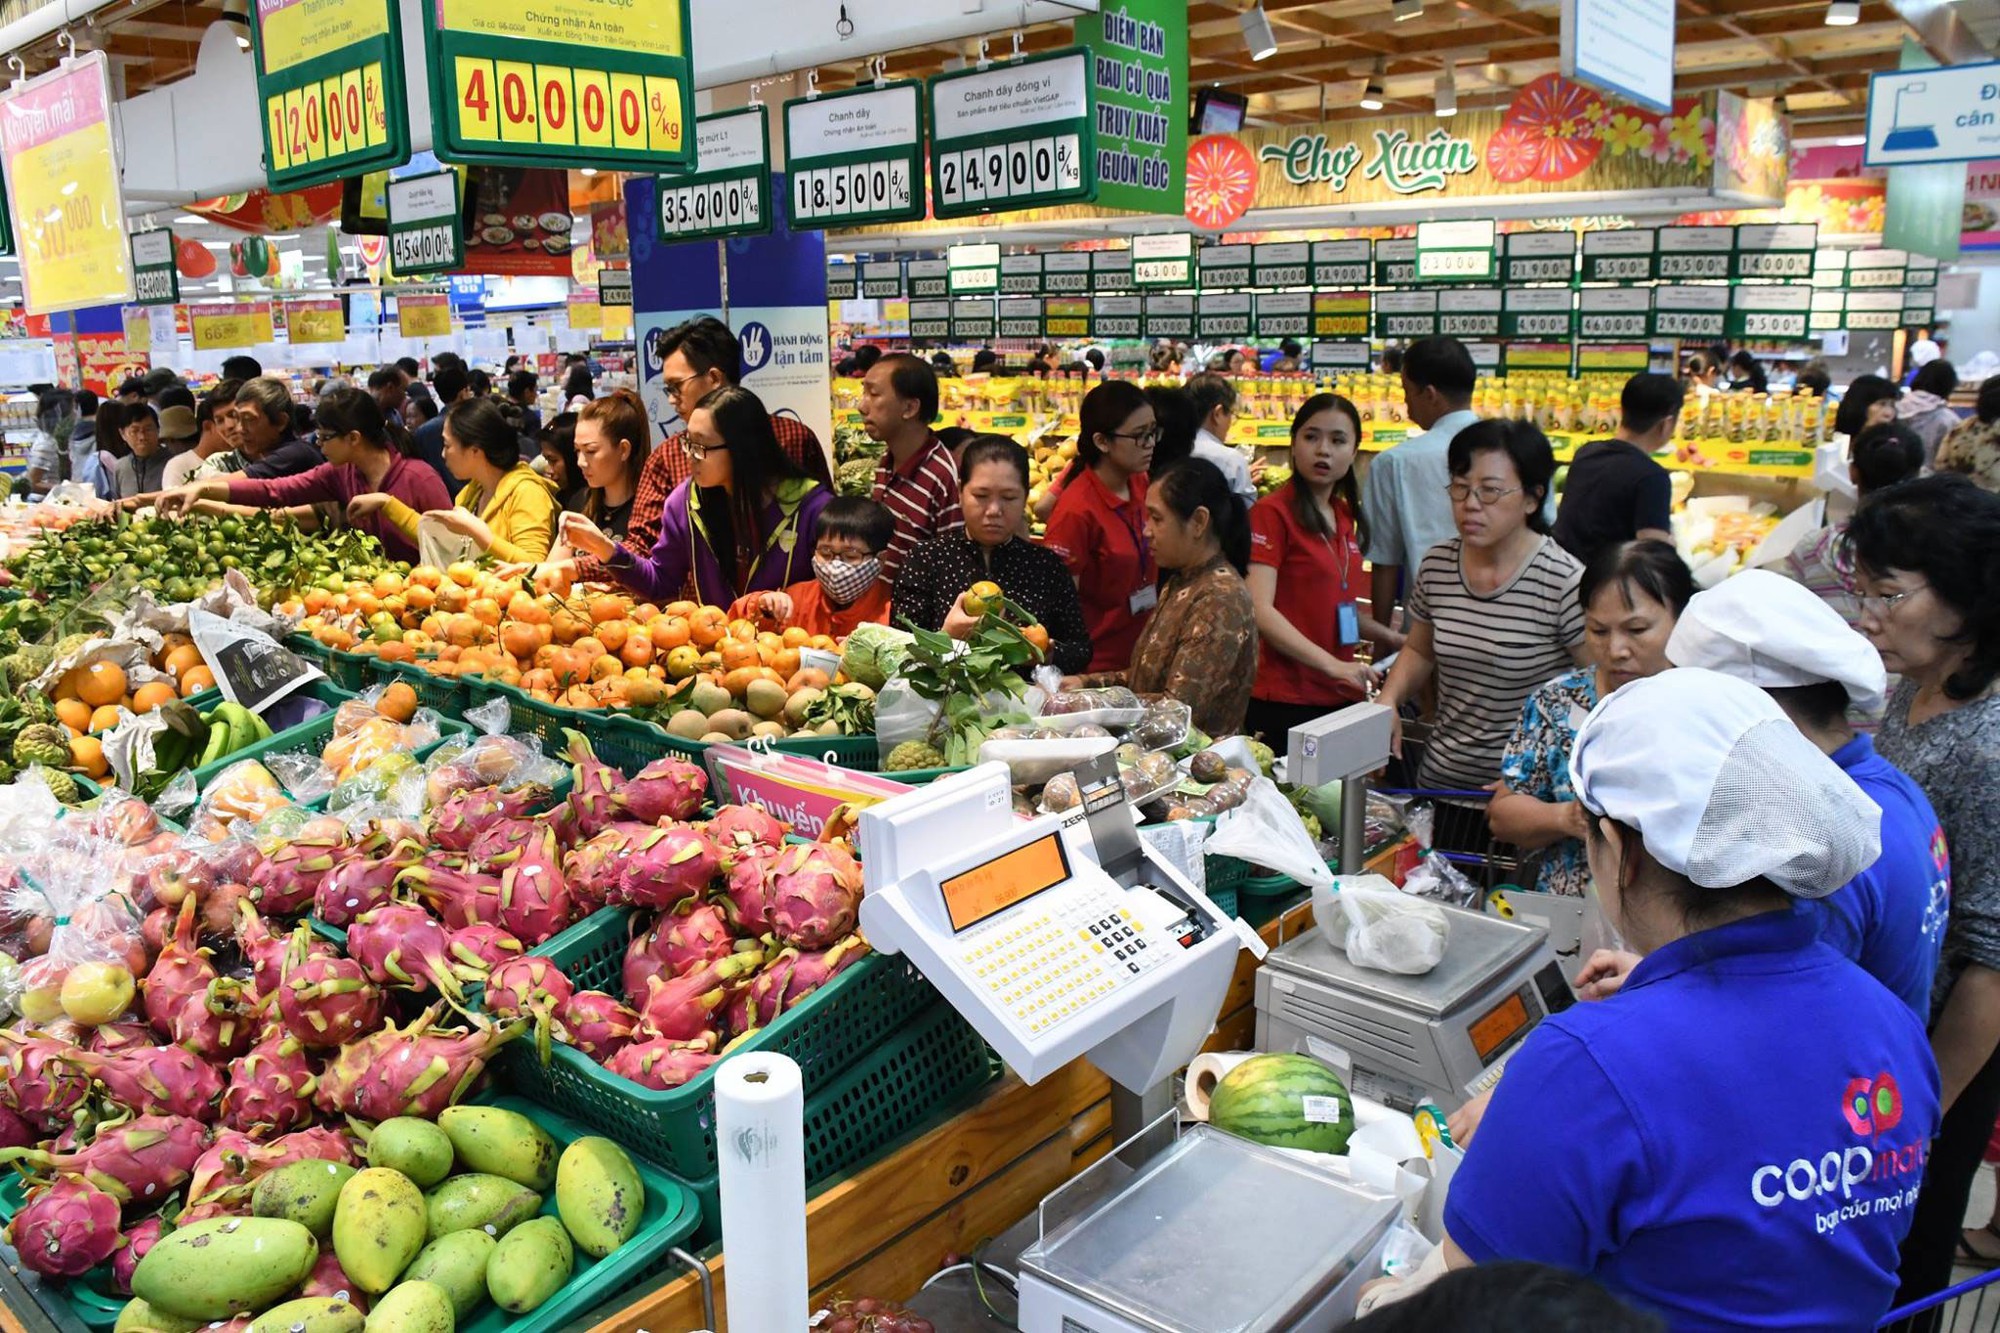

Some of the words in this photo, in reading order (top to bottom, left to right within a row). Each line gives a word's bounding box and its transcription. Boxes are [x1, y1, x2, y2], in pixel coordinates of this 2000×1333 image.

[526, 11, 560, 28] Chứng
[562, 16, 587, 29] nhận
[588, 20, 602, 31] An
[603, 22, 625, 34] toàn
[1140, 22, 1164, 58] BÁN
[964, 88, 994, 102] Chanh
[996, 85, 1013, 97] dây
[1015, 82, 1040, 93] đóng
[1096, 57, 1122, 90] RAU
[1125, 60, 1143, 96] CỦ
[1146, 68, 1171, 103] QUẢ
[275, 84, 359, 155] 12.000
[366, 76, 386, 130] đ/kg
[464, 69, 640, 136] 40.000
[651, 91, 679, 140] đ/kg
[829, 110, 855, 123] Chanh
[856, 107, 871, 120] dây
[1956, 109, 1994, 127] cân
[1097, 104, 1132, 137] TRUY
[1135, 106, 1168, 147] XUẤT
[943, 148, 1050, 194] 24.900
[1057, 144, 1079, 180] đ/kg
[1142, 151, 1170, 191] GỐC
[1261, 133, 1361, 192] Chợ
[1364, 127, 1477, 193] Xuân
[665, 188, 739, 223] 35.000
[743, 185, 758, 215] đ/kg
[800, 171, 885, 208] 18.500
[892, 170, 909, 203] đ/kg
[773, 332, 797, 346] HÀNH
[800, 331, 823, 347] ĐỘNG
[774, 349, 795, 369] tận
[800, 348, 823, 364] tâm
[1816, 1210, 1840, 1235] bạn
[1841, 1199, 1871, 1221] của
[1874, 1189, 1903, 1216] mọi
